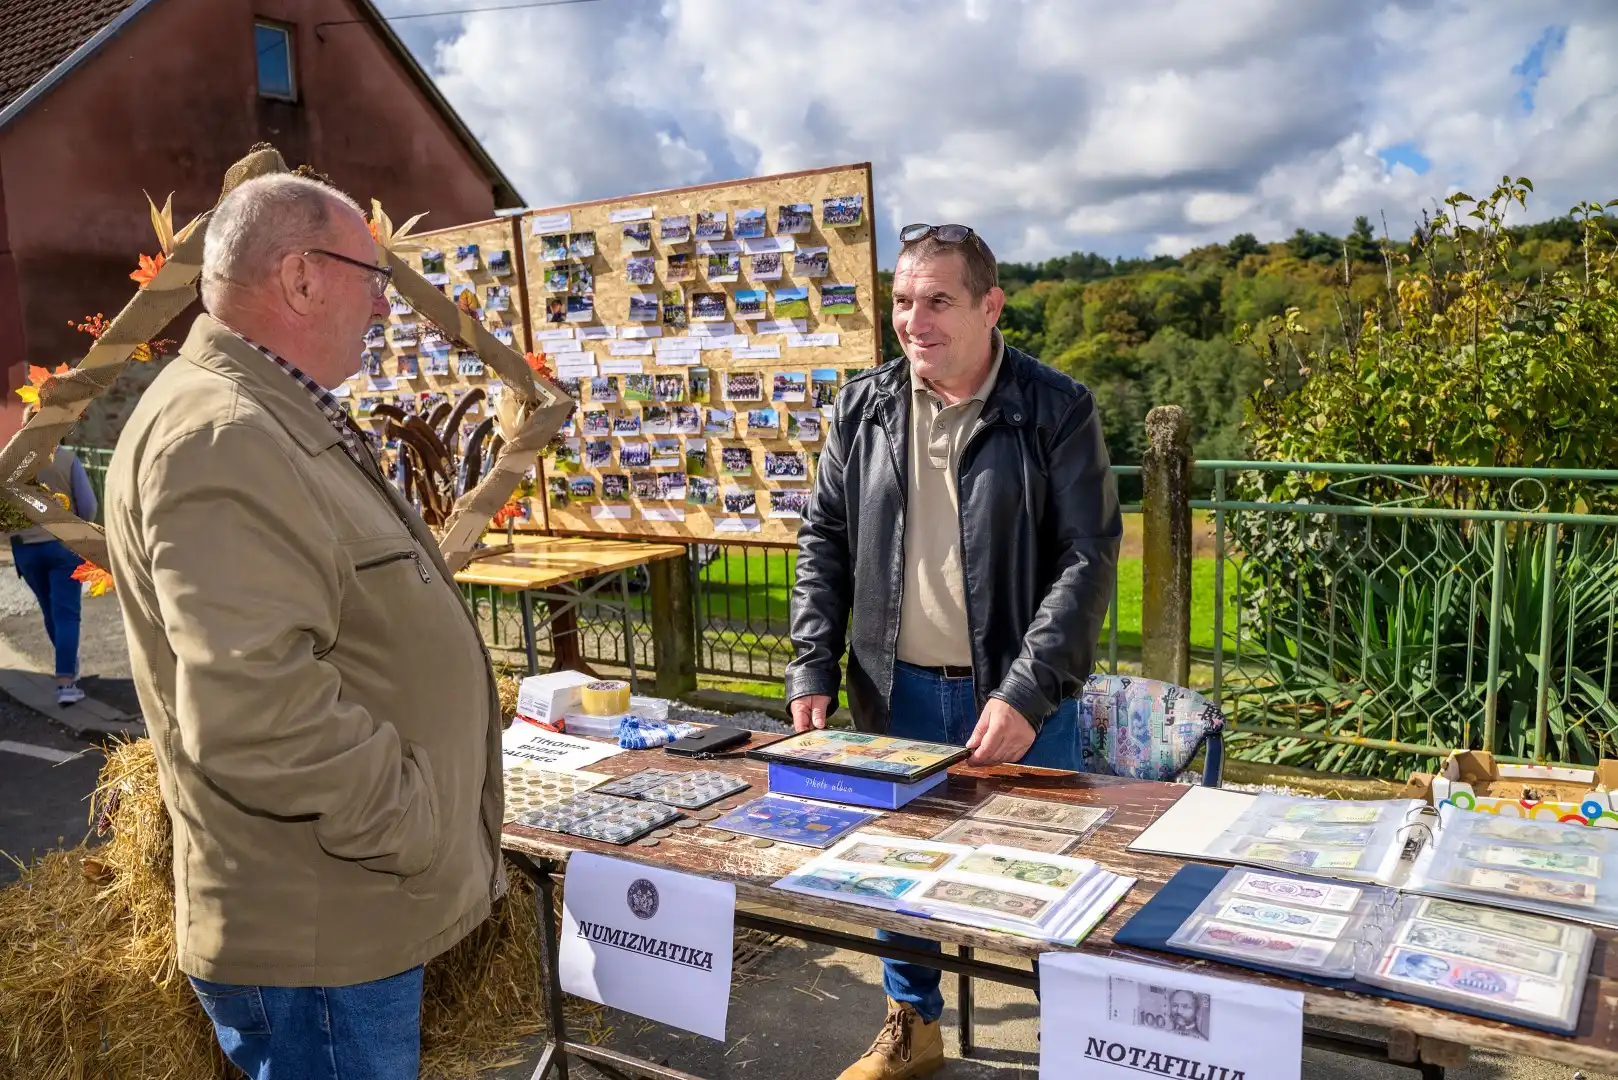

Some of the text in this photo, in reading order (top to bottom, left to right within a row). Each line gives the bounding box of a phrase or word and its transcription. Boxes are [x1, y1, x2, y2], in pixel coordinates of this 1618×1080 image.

[805, 777, 828, 790] Photo
[578, 920, 713, 970] NUMIZMATIKA
[1139, 1010, 1166, 1028] 100
